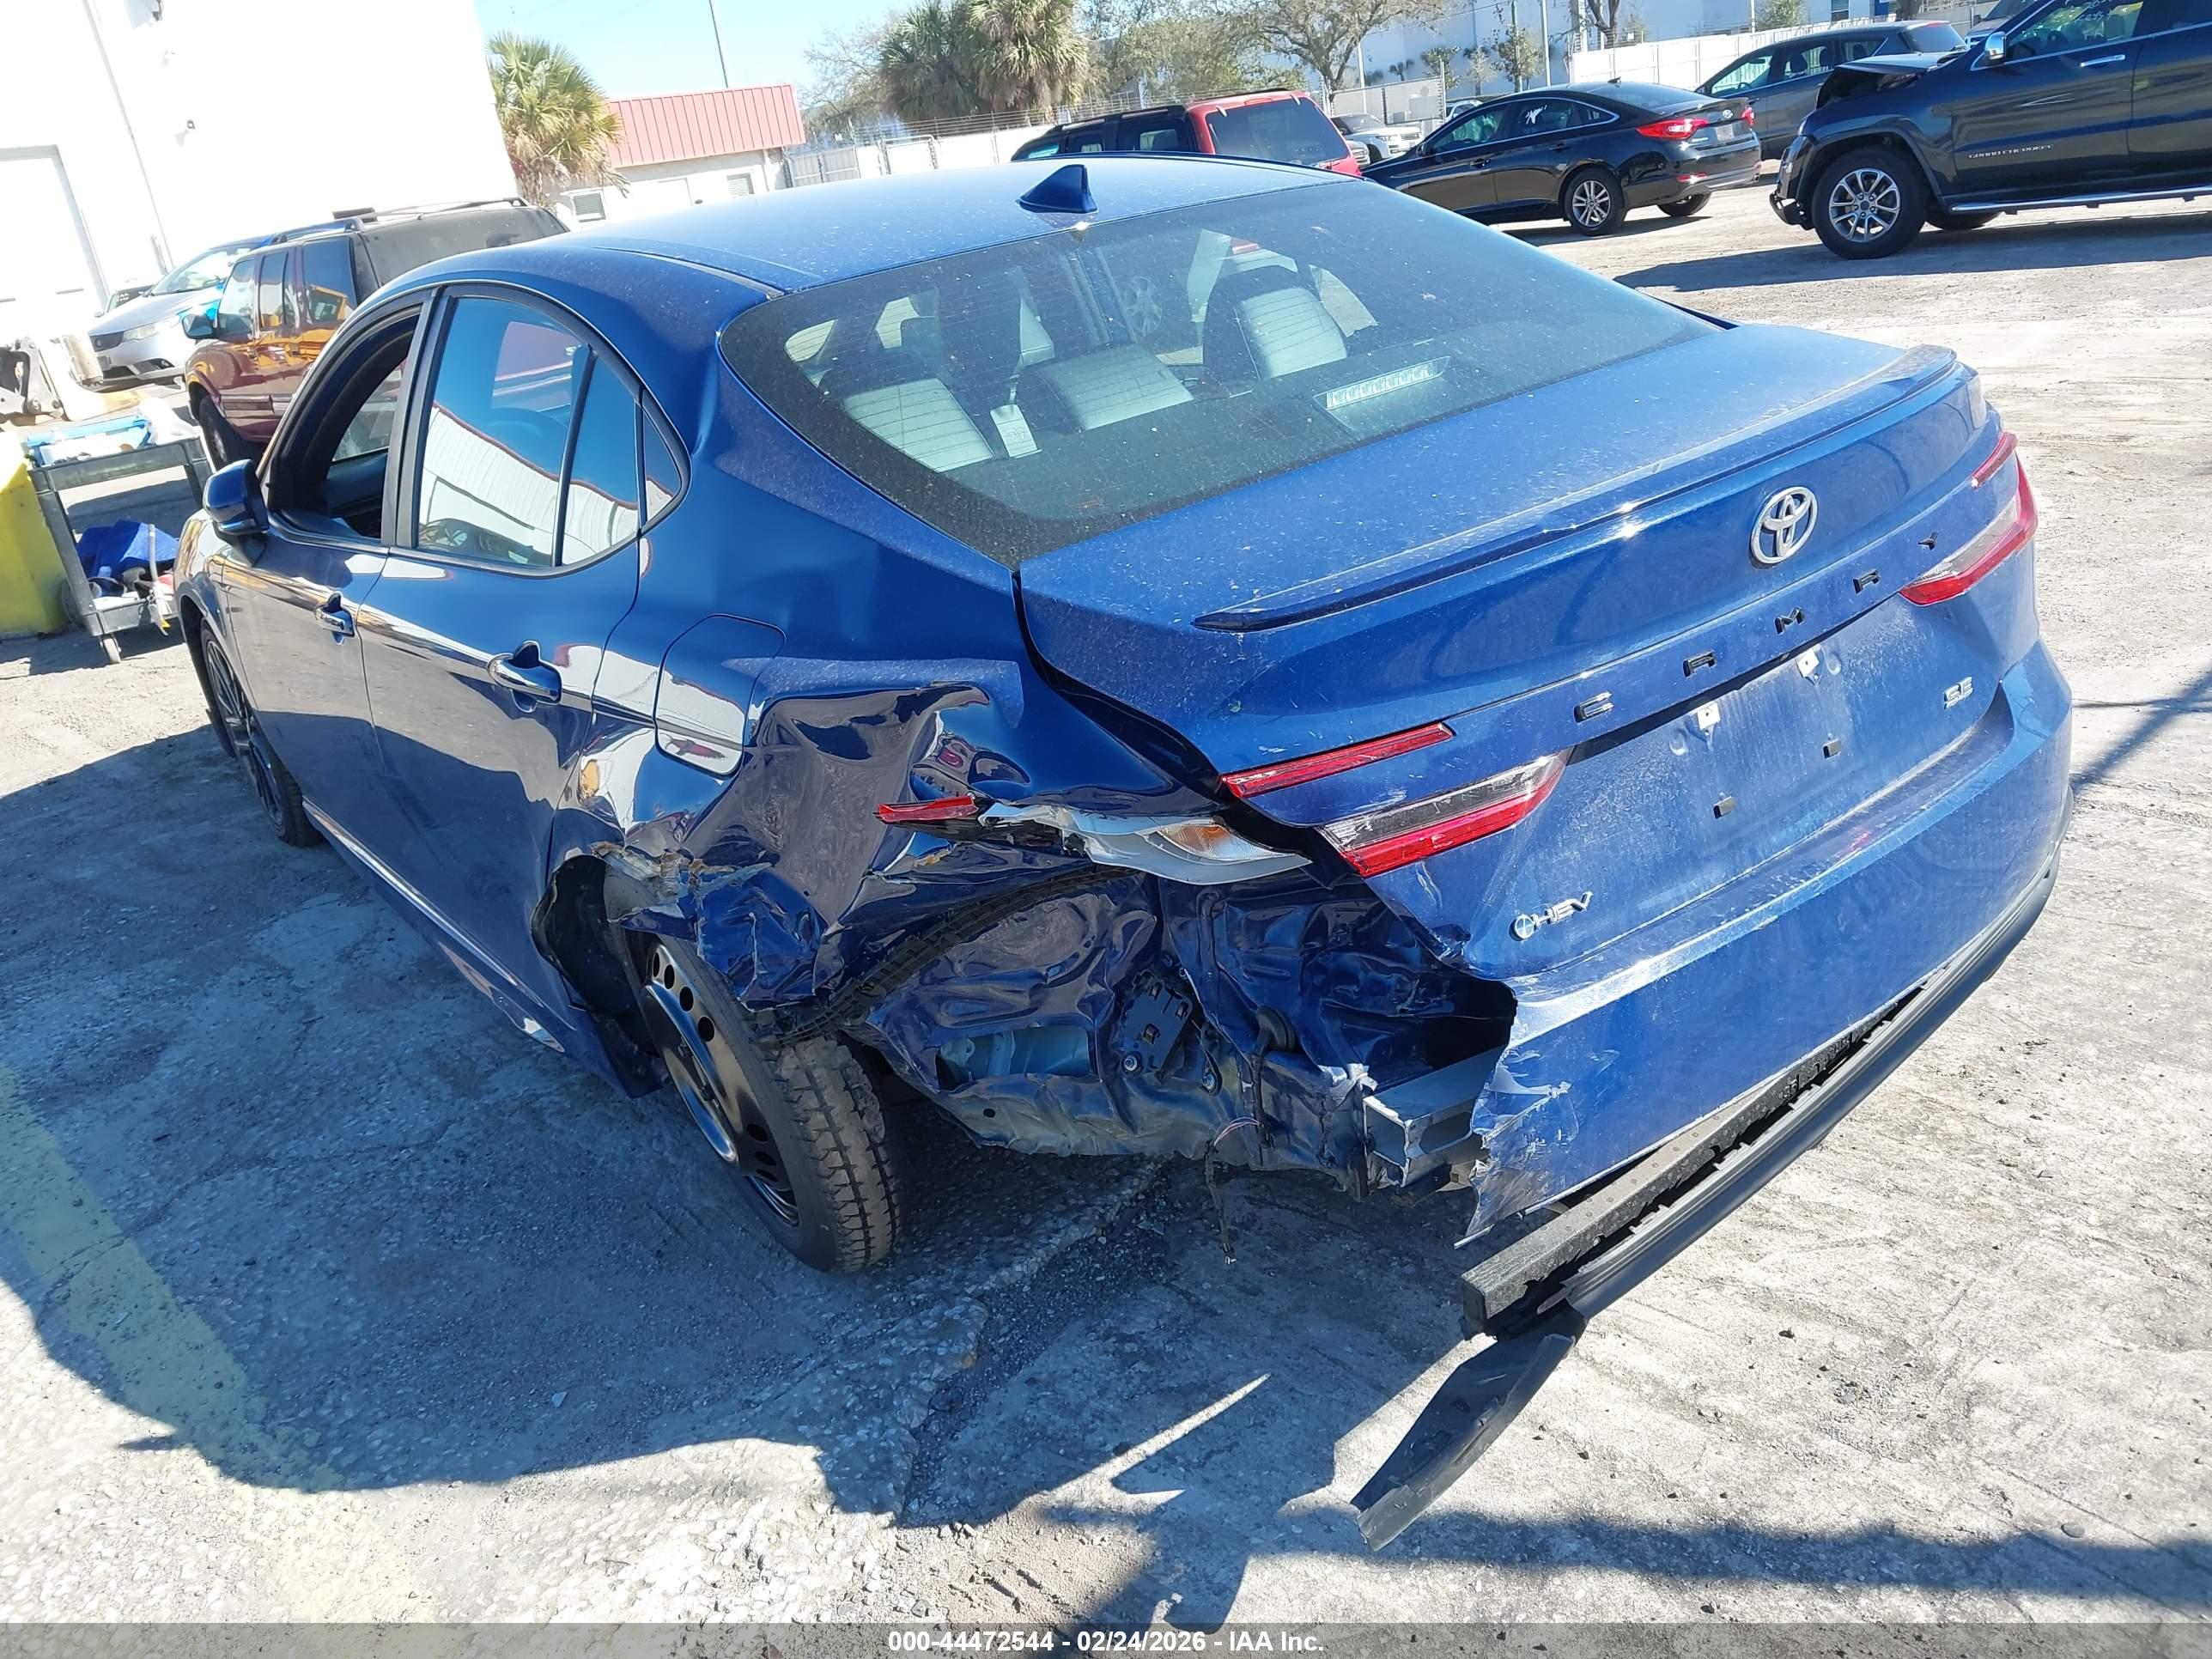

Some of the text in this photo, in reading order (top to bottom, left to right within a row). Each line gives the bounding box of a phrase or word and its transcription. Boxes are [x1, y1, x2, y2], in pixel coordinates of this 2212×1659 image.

[1573, 531, 1940, 724] CAMRY
[1943, 675, 1974, 710] SE
[1530, 890, 1595, 932] HEV
